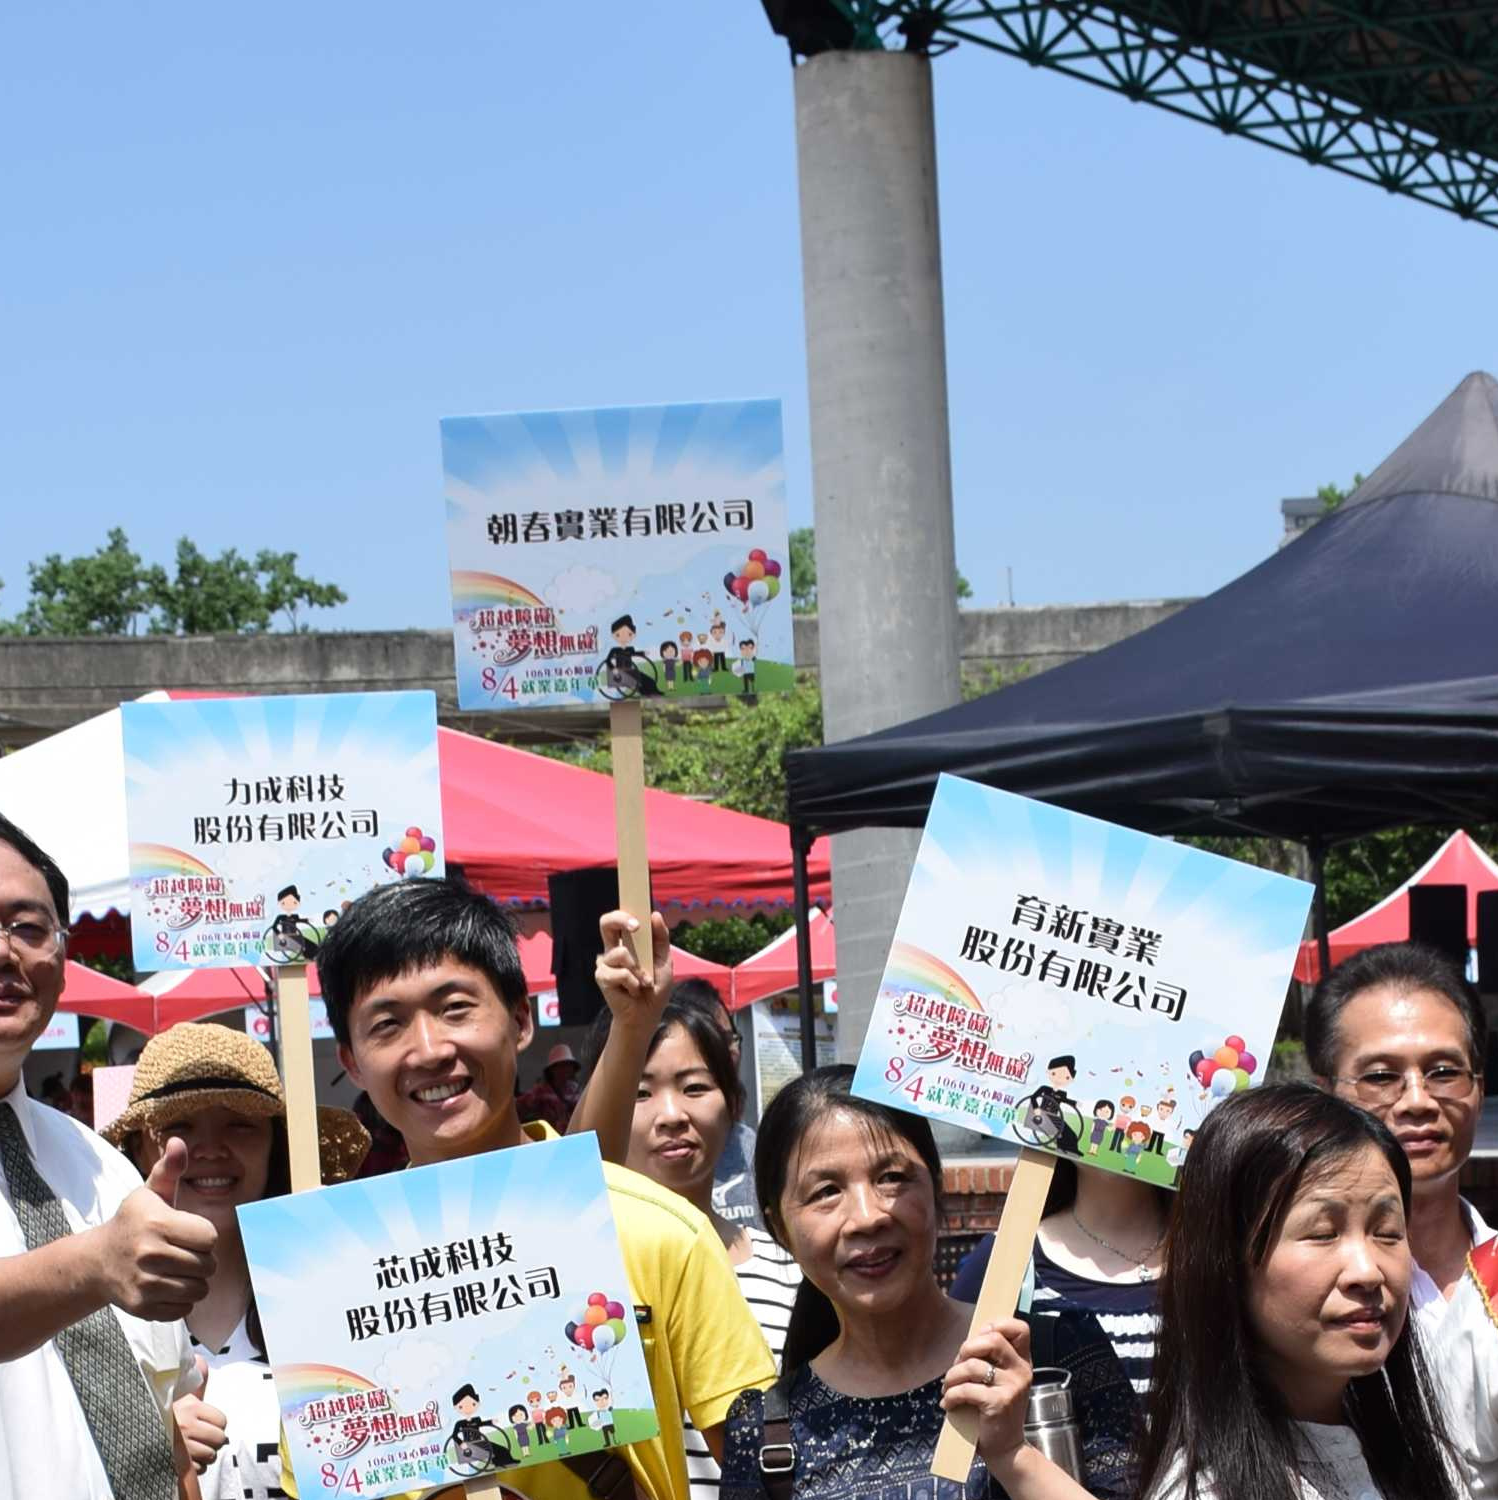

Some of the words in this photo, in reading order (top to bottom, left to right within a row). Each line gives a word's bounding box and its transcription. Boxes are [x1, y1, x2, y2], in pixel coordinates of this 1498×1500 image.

[487, 499, 753, 544] 朝春實業有限公司
[481, 667, 518, 700] 8/4
[223, 774, 346, 806] 力成科技
[193, 809, 379, 845] 股份有限公司
[1012, 894, 1163, 967] 育新實業
[959, 925, 1188, 1022] 股份有限公司
[885, 1057, 924, 1101] 8/4
[373, 1232, 518, 1290] 芯成科技
[346, 1266, 561, 1342] 股份有限公司
[321, 1462, 364, 1498] 8/4
